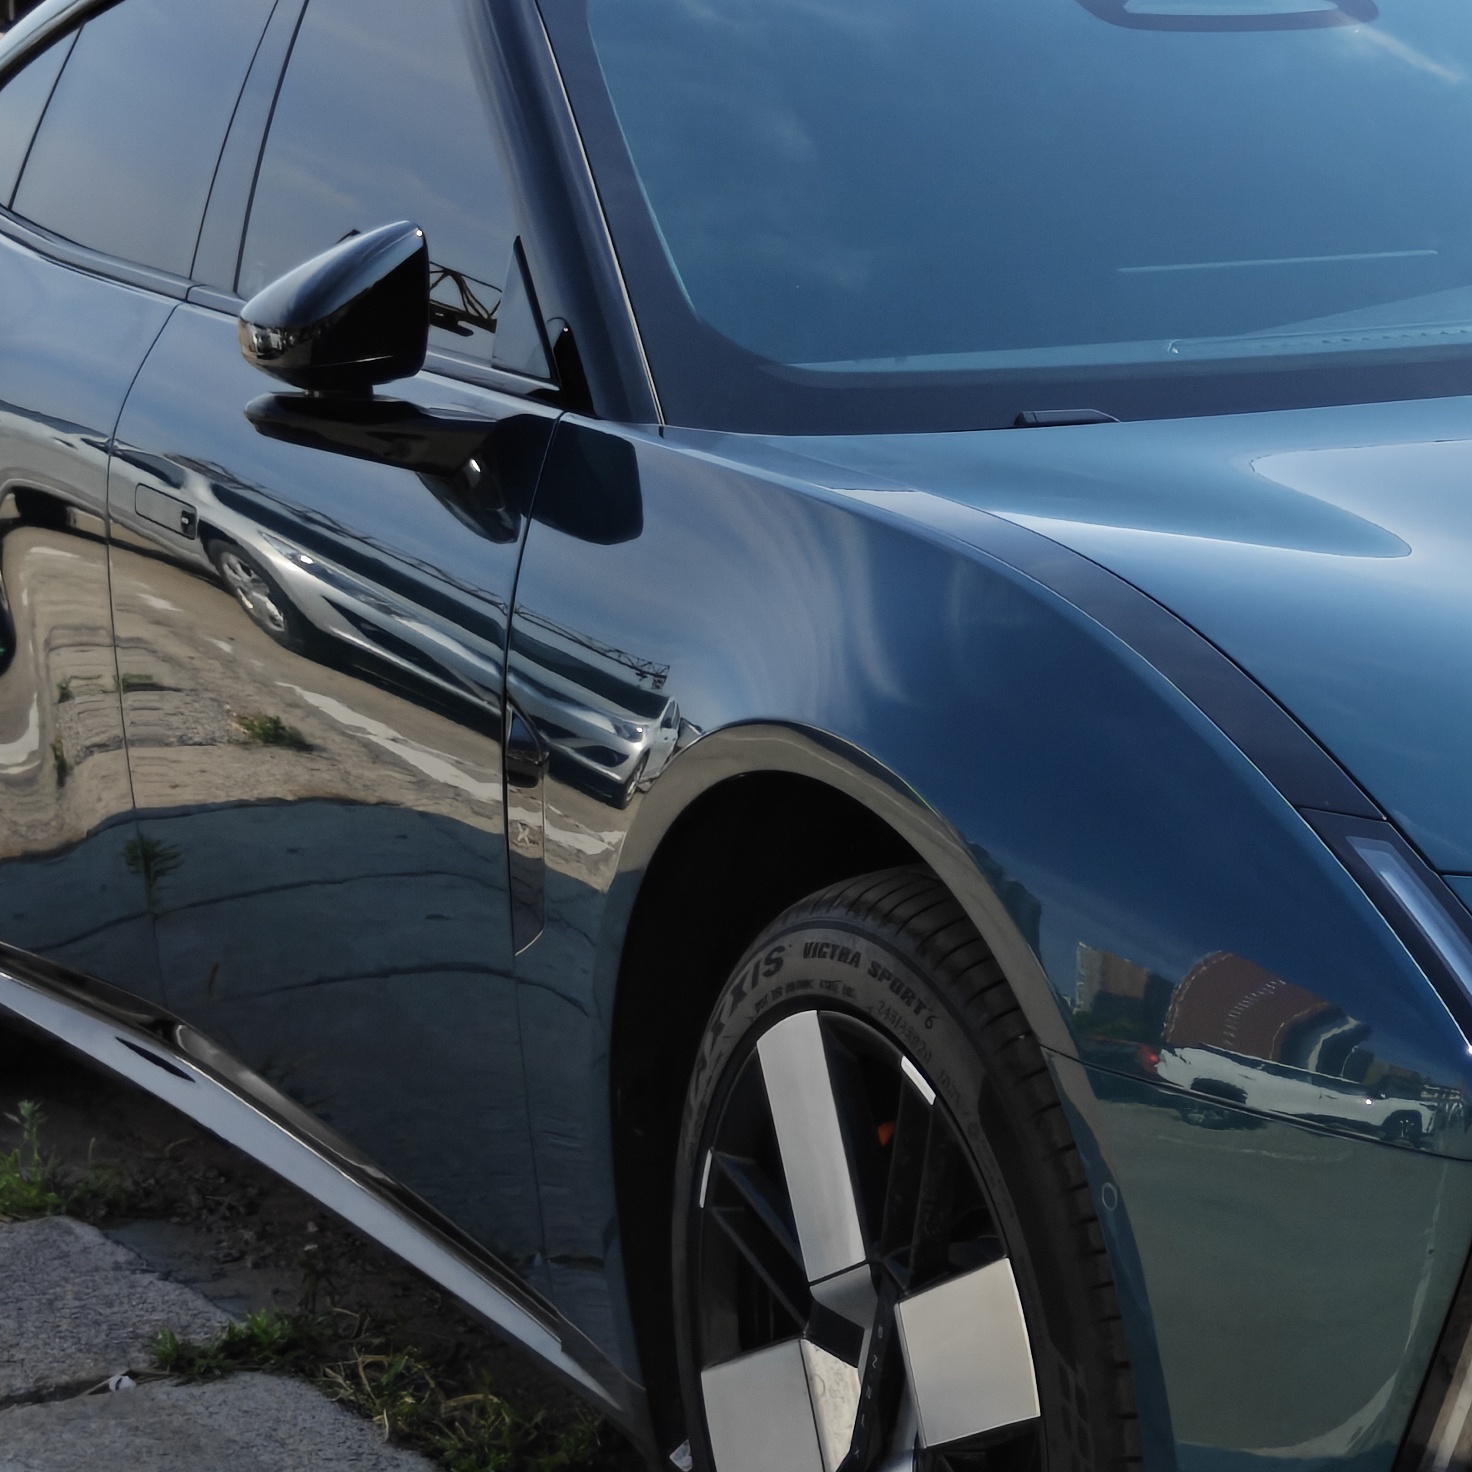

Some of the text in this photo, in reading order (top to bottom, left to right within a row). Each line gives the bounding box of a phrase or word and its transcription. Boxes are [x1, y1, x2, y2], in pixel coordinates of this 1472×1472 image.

[802, 941, 863, 969] VICTRA
[866, 960, 927, 1016] SPORT
[924, 1010, 940, 1030] 6
